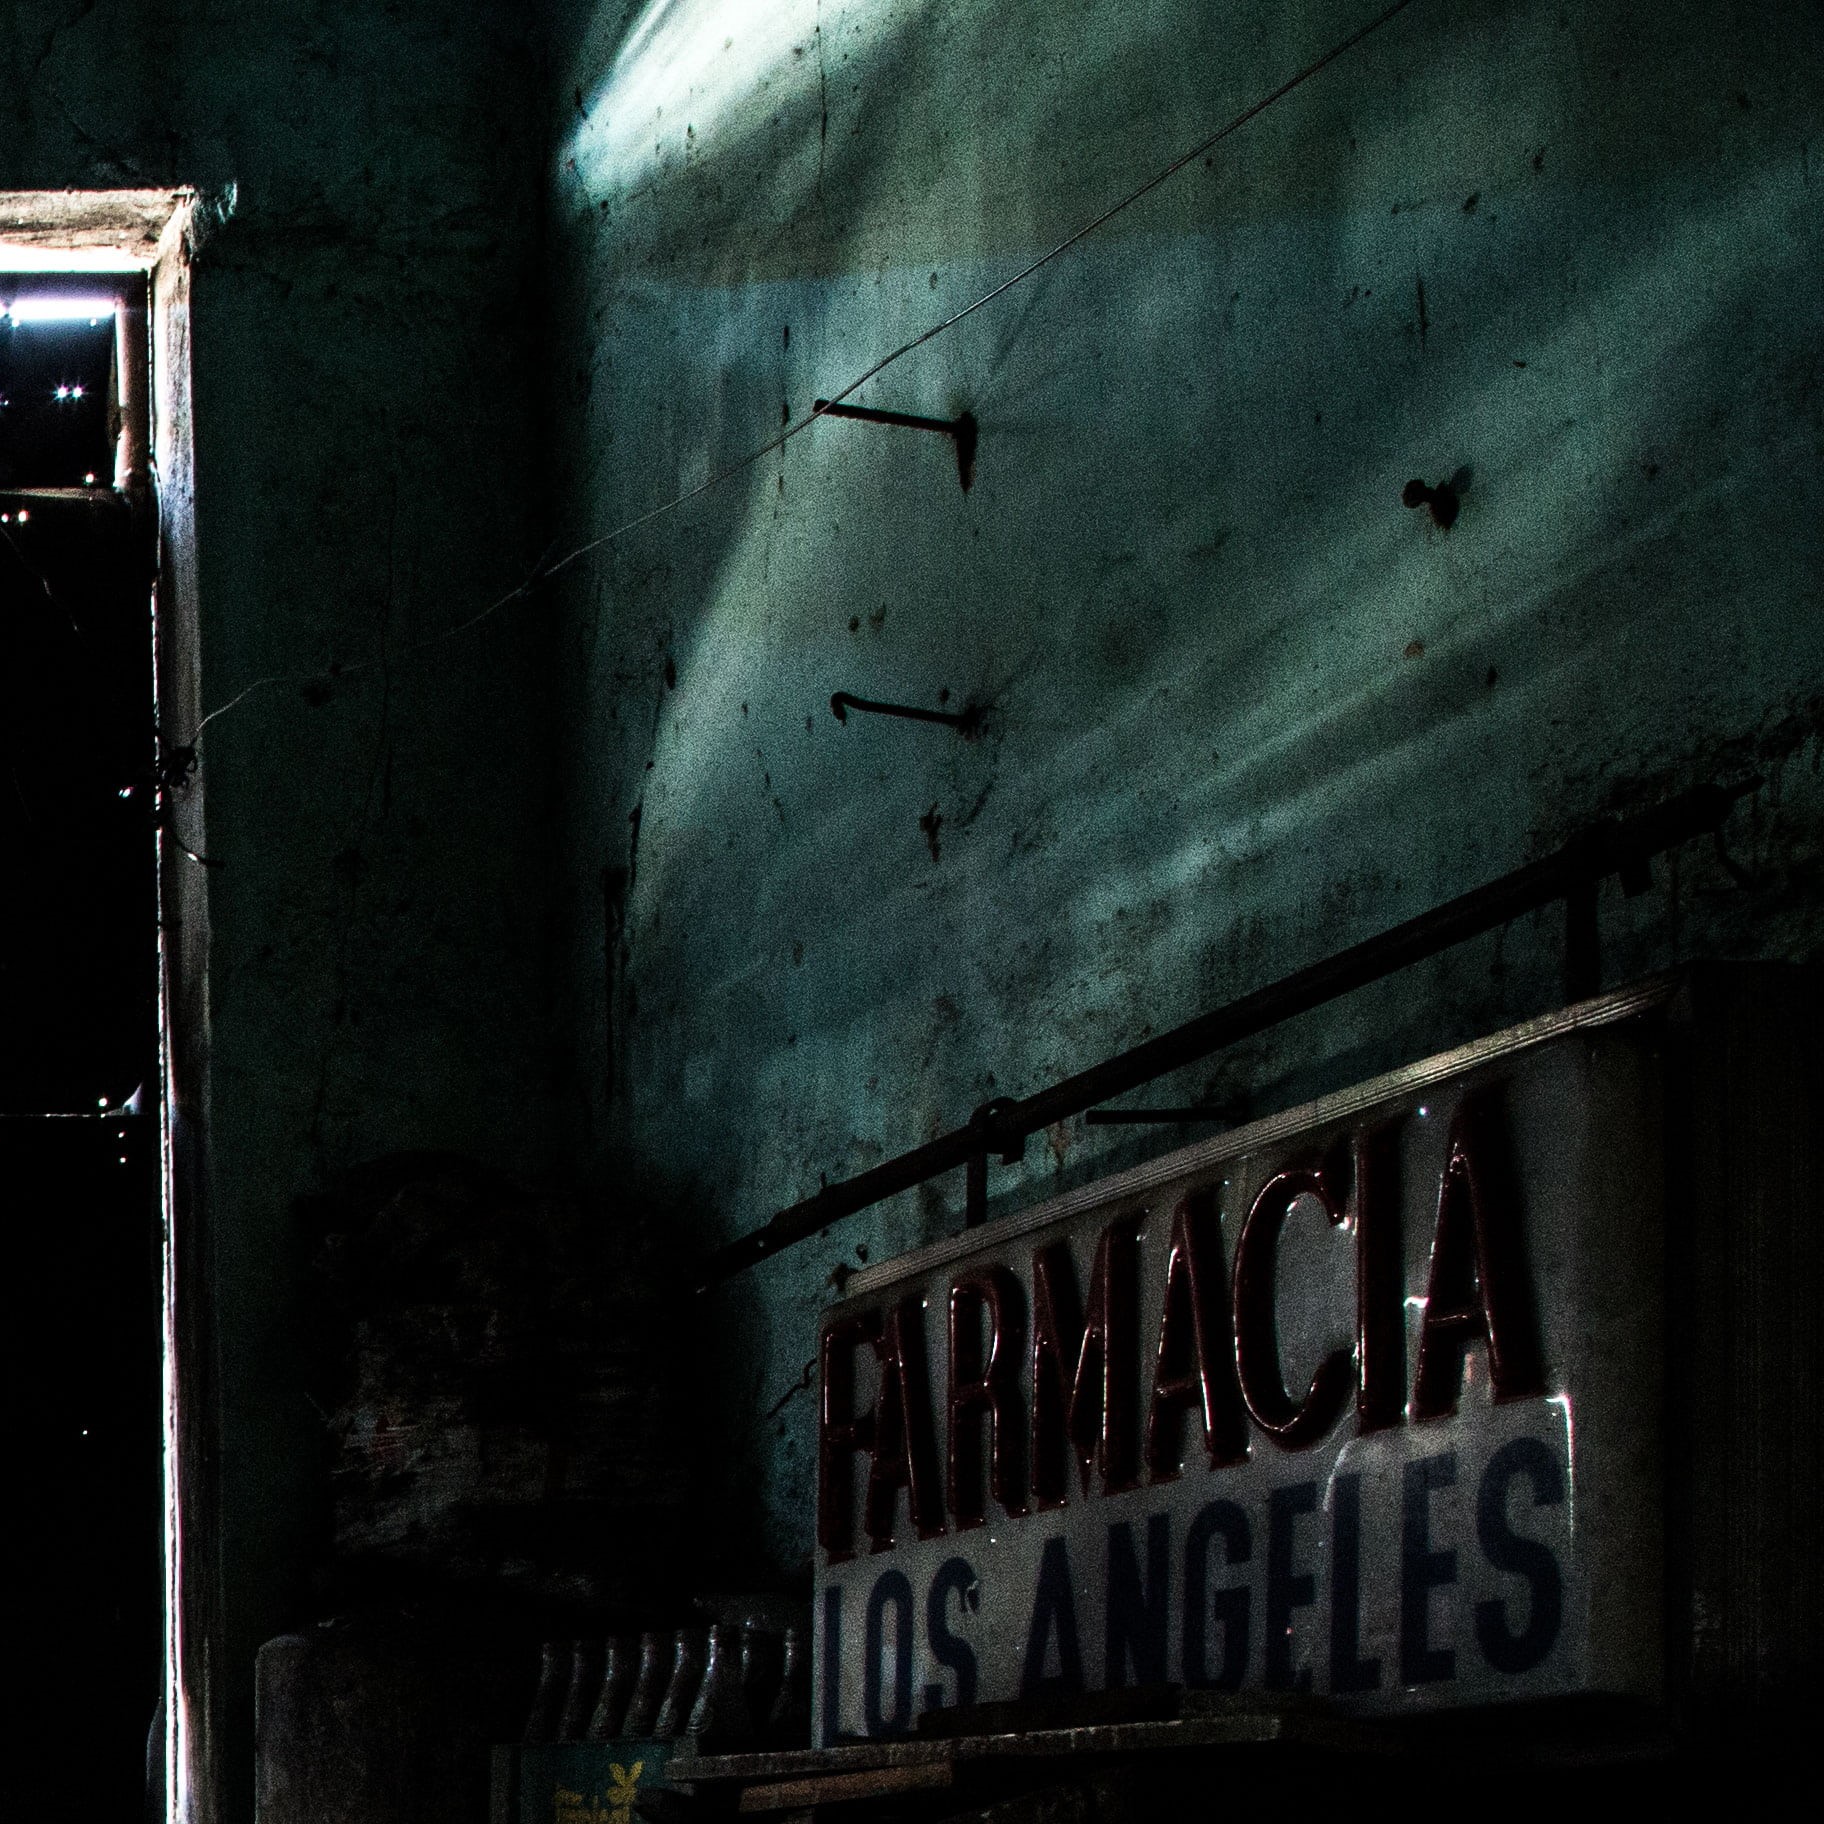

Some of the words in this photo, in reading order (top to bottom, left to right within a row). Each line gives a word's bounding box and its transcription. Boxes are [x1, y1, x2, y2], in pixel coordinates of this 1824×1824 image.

[820, 1078, 1547, 1563] FARMACIA
[822, 1556, 980, 1748] LOS
[1020, 1436, 1564, 1702] ANGELES
